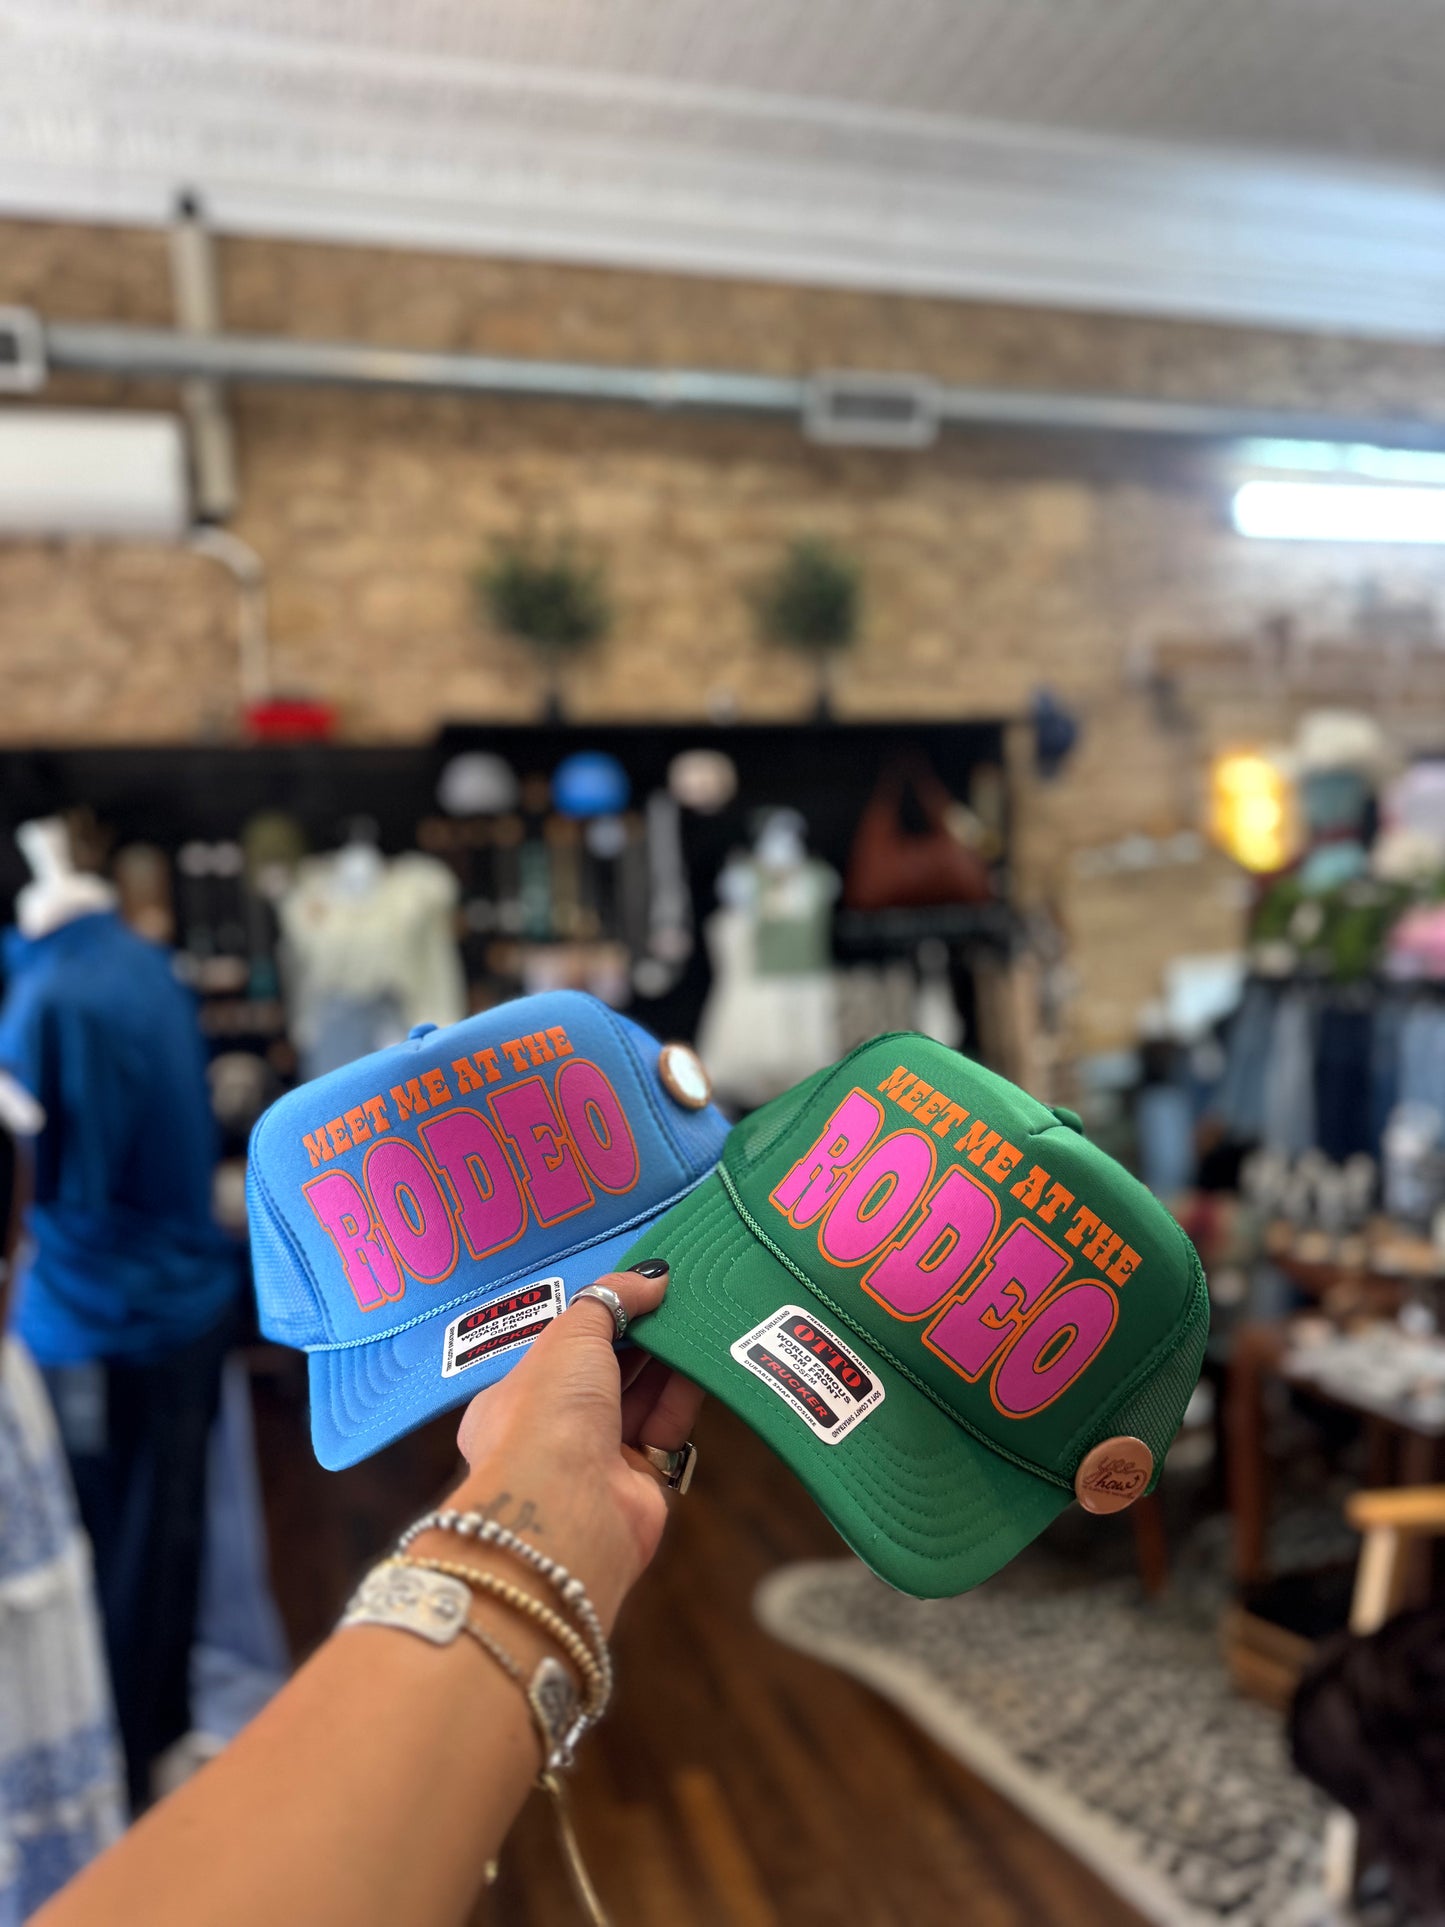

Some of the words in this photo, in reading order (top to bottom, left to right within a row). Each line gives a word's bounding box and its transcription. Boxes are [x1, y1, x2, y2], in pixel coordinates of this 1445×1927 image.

[302, 1095, 391, 1168] MEET
[390, 1068, 453, 1121] ME
[451, 1048, 501, 1092] AT
[500, 1025, 574, 1072] THE
[302, 1058, 640, 1313] RODEO
[877, 1065, 970, 1138] MEET
[954, 1118, 1024, 1178] ME
[1010, 1164, 1075, 1223] AT
[1064, 1205, 1143, 1288] THE
[768, 1086, 1119, 1419] RODEO
[461, 1321, 499, 1341] WORLD
[502, 1303, 548, 1322] FAMOUS
[467, 1291, 541, 1328] OTTO
[467, 1322, 544, 1358] TRUCKER
[469, 1325, 499, 1342] FOAM
[502, 1310, 540, 1327] FRONT
[776, 1332, 812, 1363] WORLD
[814, 1362, 851, 1404] FAMOUS
[778, 1343, 808, 1368] FOAM
[809, 1367, 841, 1400] FRONT
[792, 1363, 818, 1386] OSFM
[793, 1324, 862, 1388] OTTO
[806, 1315, 834, 1338] PREMIUM
[834, 1337, 852, 1356] FOAM
[851, 1354, 872, 1376] FABRIC
[744, 1359, 773, 1382] DURABLE
[772, 1381, 791, 1399] SNAP
[790, 1399, 817, 1427] CLOSURE
[759, 1353, 828, 1417] TRUCKER
